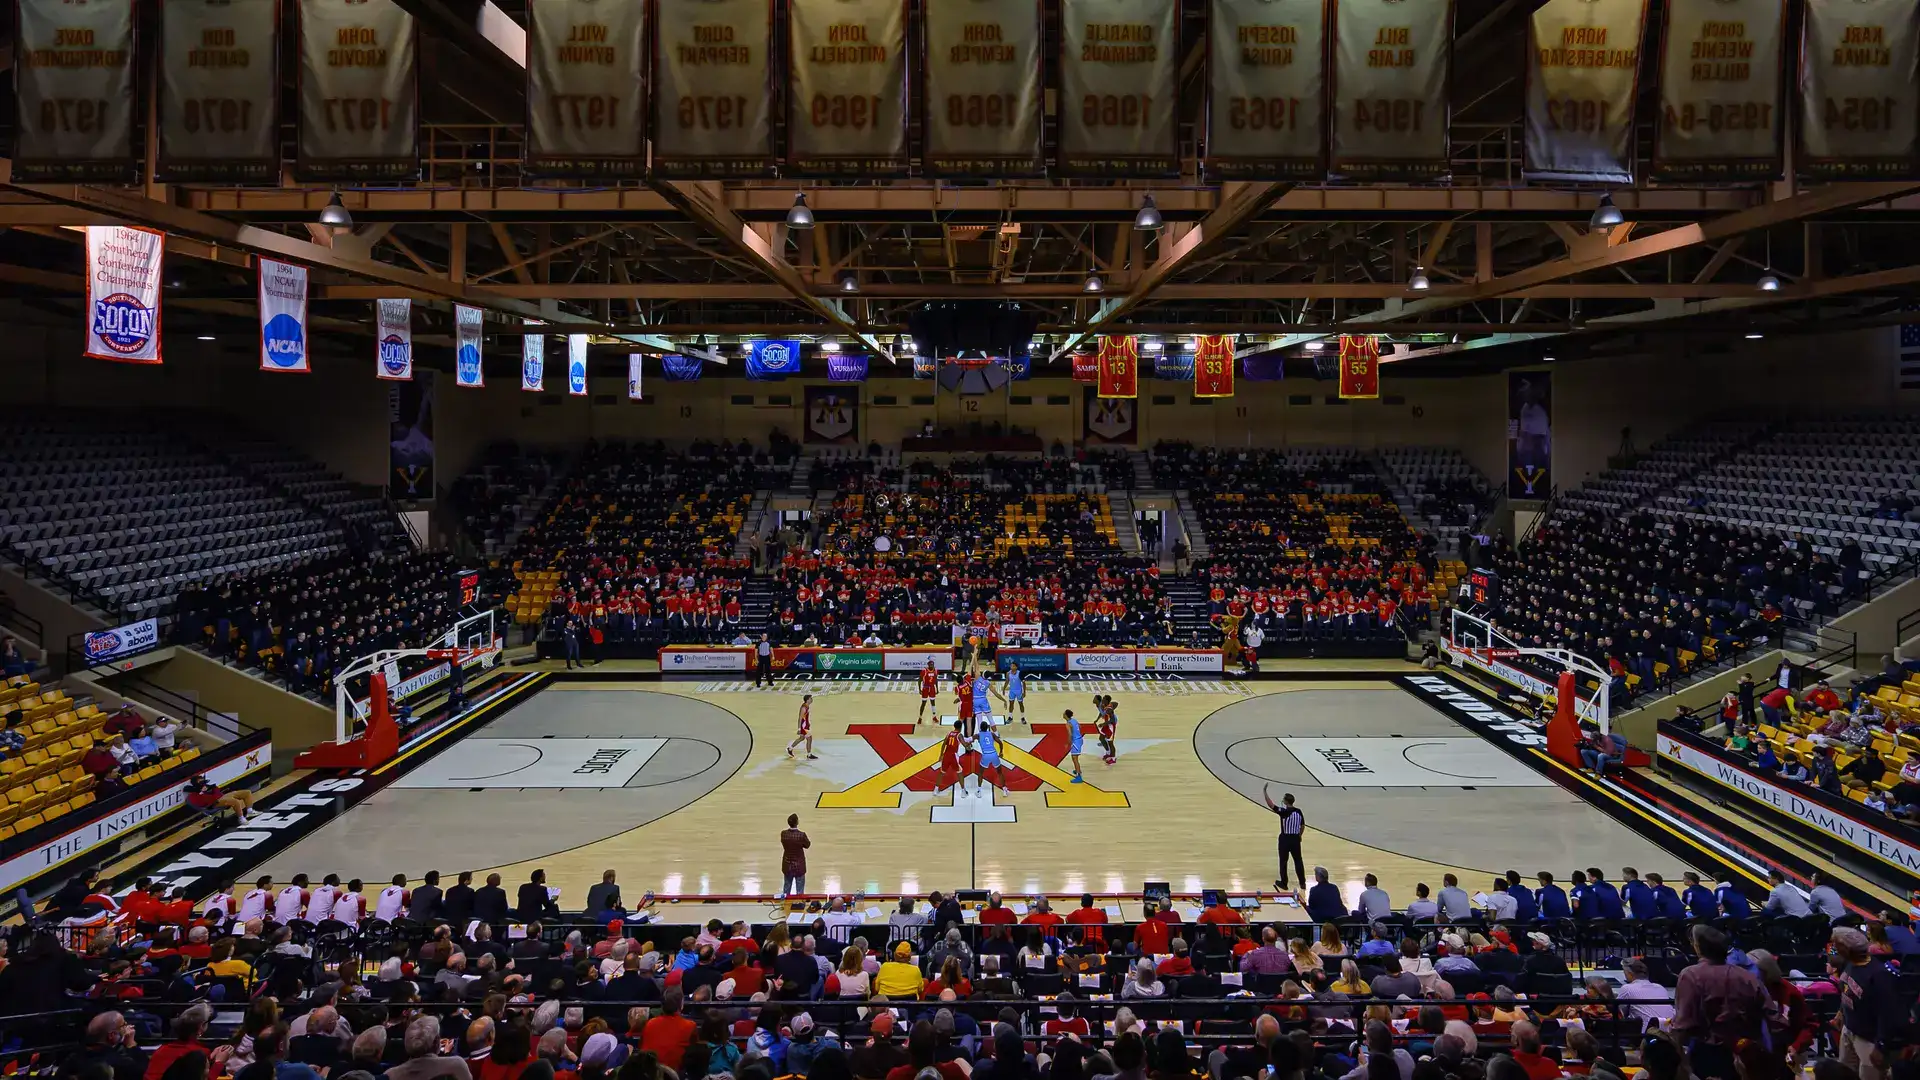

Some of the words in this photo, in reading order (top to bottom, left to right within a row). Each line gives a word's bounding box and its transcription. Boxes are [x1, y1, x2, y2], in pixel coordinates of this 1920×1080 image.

[116, 228, 140, 243] 1964
[103, 241, 149, 260] Southern
[97, 255, 154, 276] Conference
[276, 263, 293, 275] 1964
[96, 270, 154, 290] Champions
[274, 276, 296, 288] NCAA
[95, 300, 155, 337] SOCON
[268, 338, 303, 355] NCAA
[762, 346, 790, 364] SOCON
[833, 365, 863, 373] FURMAN
[1110, 363, 1126, 375] 13
[1206, 362, 1222, 374] 33
[1351, 361, 1368, 375] 55
[680, 406, 692, 418] 13
[966, 401, 978, 412] 12
[134, 622, 153, 634] sub
[128, 633, 154, 647] above
[837, 658, 860, 666] Virginia
[861, 658, 881, 666] Lottery
[1161, 654, 1215, 662] CornerStone
[1055, 672, 1186, 680] VIRGINIA
[397, 681, 418, 698] RAH
[961, 687, 971, 695] 42
[1404, 675, 1548, 746] KEYDETS
[948, 737, 955, 745] 11
[985, 737, 990, 745] 3
[573, 748, 631, 774] SOCON
[1315, 748, 1376, 774] SOCON
[1716, 762, 1781, 808] WHOLE
[1791, 796, 1855, 841] DAMN
[1863, 827, 1920, 870] TEAM
[40, 835, 82, 866] THE
[97, 788, 184, 841] INSTITUTE
[113, 777, 365, 899] EYDETS
